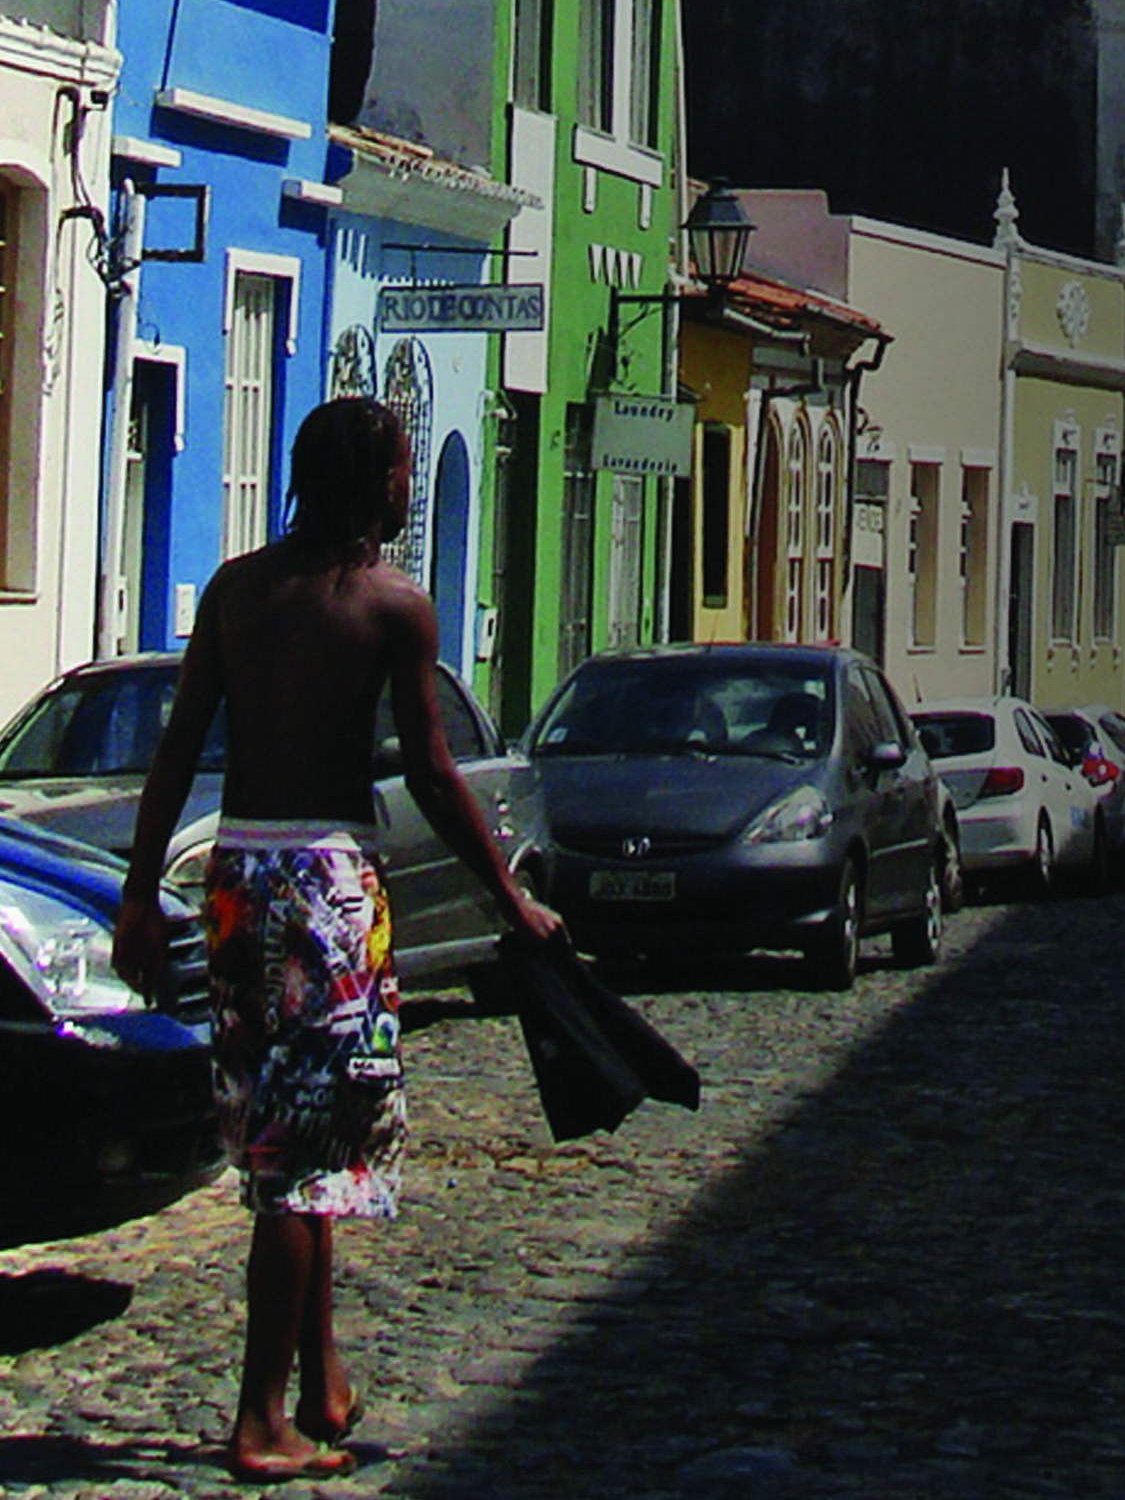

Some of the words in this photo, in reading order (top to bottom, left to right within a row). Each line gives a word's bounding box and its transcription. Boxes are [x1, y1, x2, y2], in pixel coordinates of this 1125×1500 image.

[381, 295, 427, 322] RIO
[429, 294, 457, 321] DE
[458, 294, 540, 320] CONTAS
[614, 402, 674, 422] Laundry
